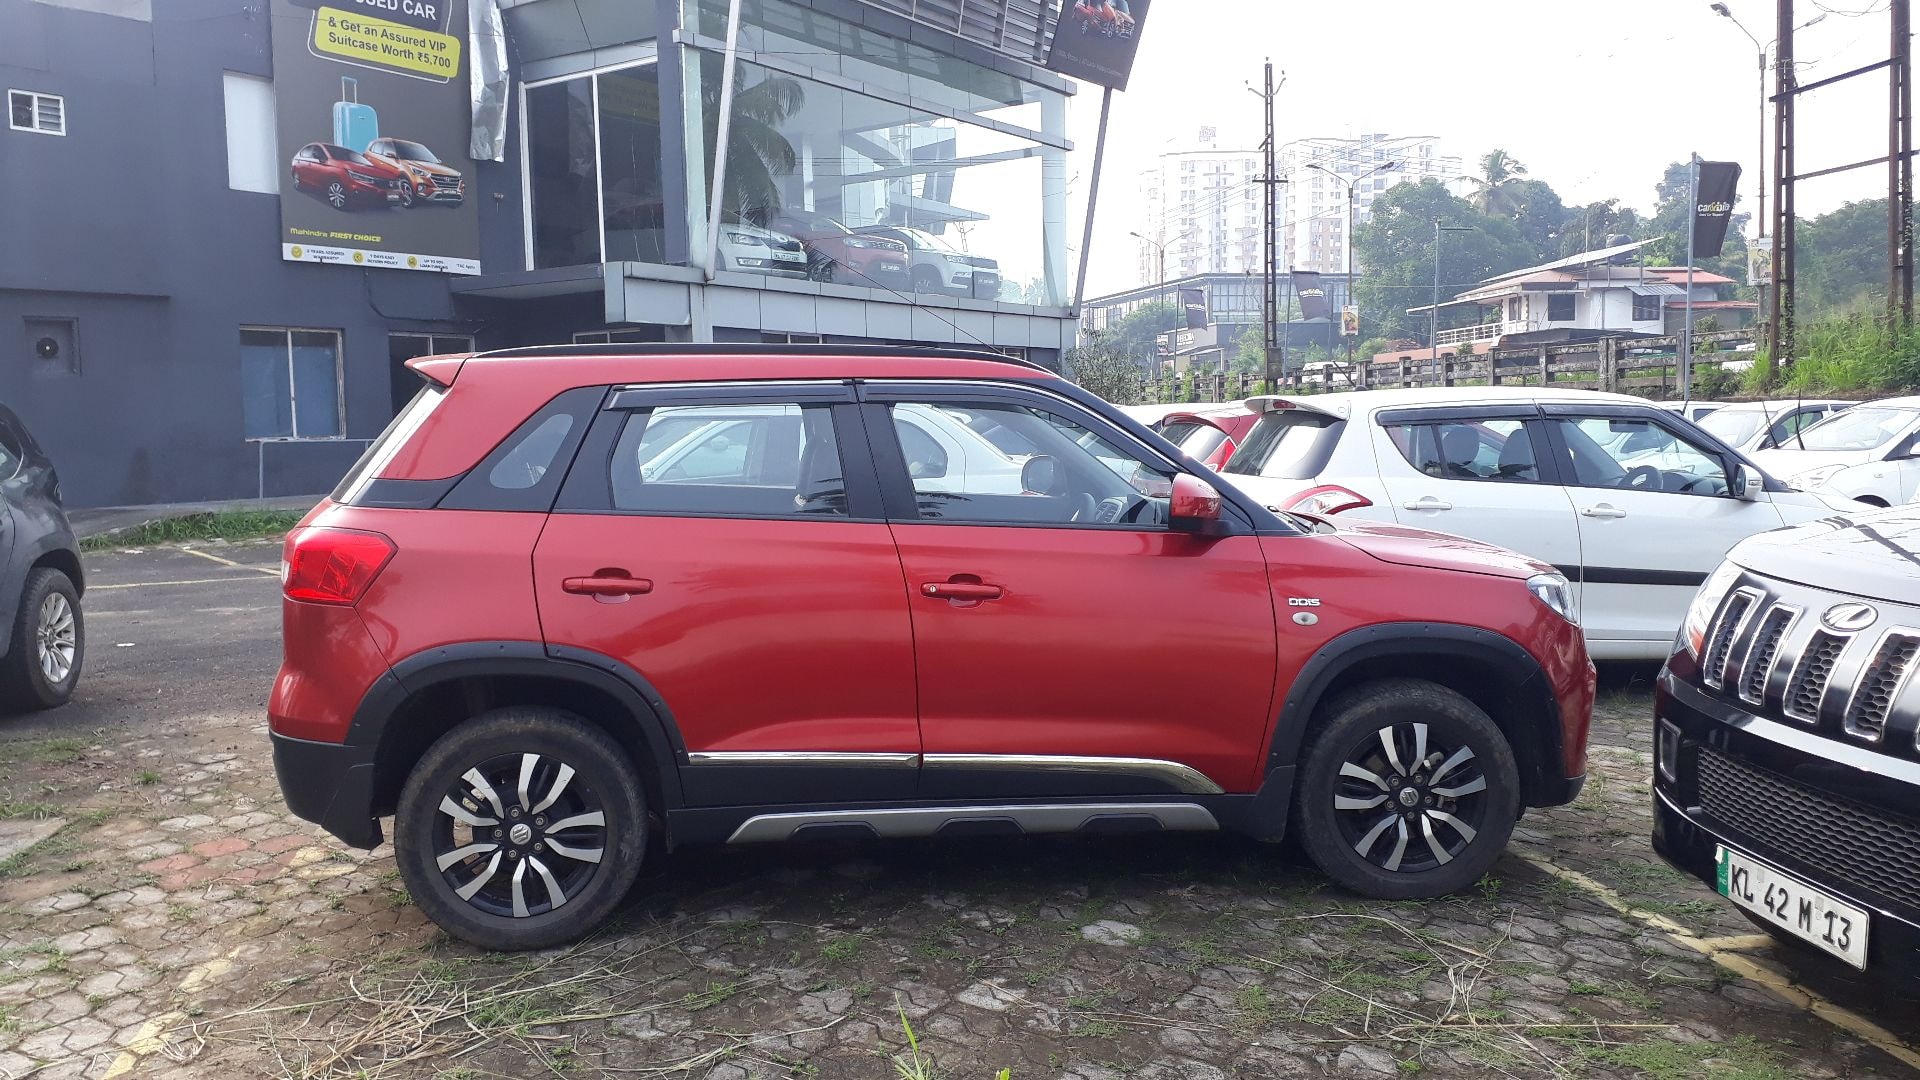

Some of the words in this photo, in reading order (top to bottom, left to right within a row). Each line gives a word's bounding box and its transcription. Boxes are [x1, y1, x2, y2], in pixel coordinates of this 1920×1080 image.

[354, 0, 398, 10] ED
[402, 0, 436, 20] CAR
[328, 16, 336, 28] &
[340, 20, 360, 33] Get
[364, 25, 378, 36] an
[380, 28, 426, 48] Assured
[428, 40, 446, 51] VIP
[328, 32, 378, 52] Suitcase
[381, 44, 414, 60] Worth
[417, 52, 450, 68] ₹5,700
[290, 228, 328, 238] Mahindra
[330, 232, 353, 240] FIRST
[354, 234, 381, 242] CHOICE
[1731, 864, 1754, 904] KL
[1764, 882, 1789, 922] 42
[1798, 896, 1812, 932] M
[1822, 910, 1852, 952] 13
